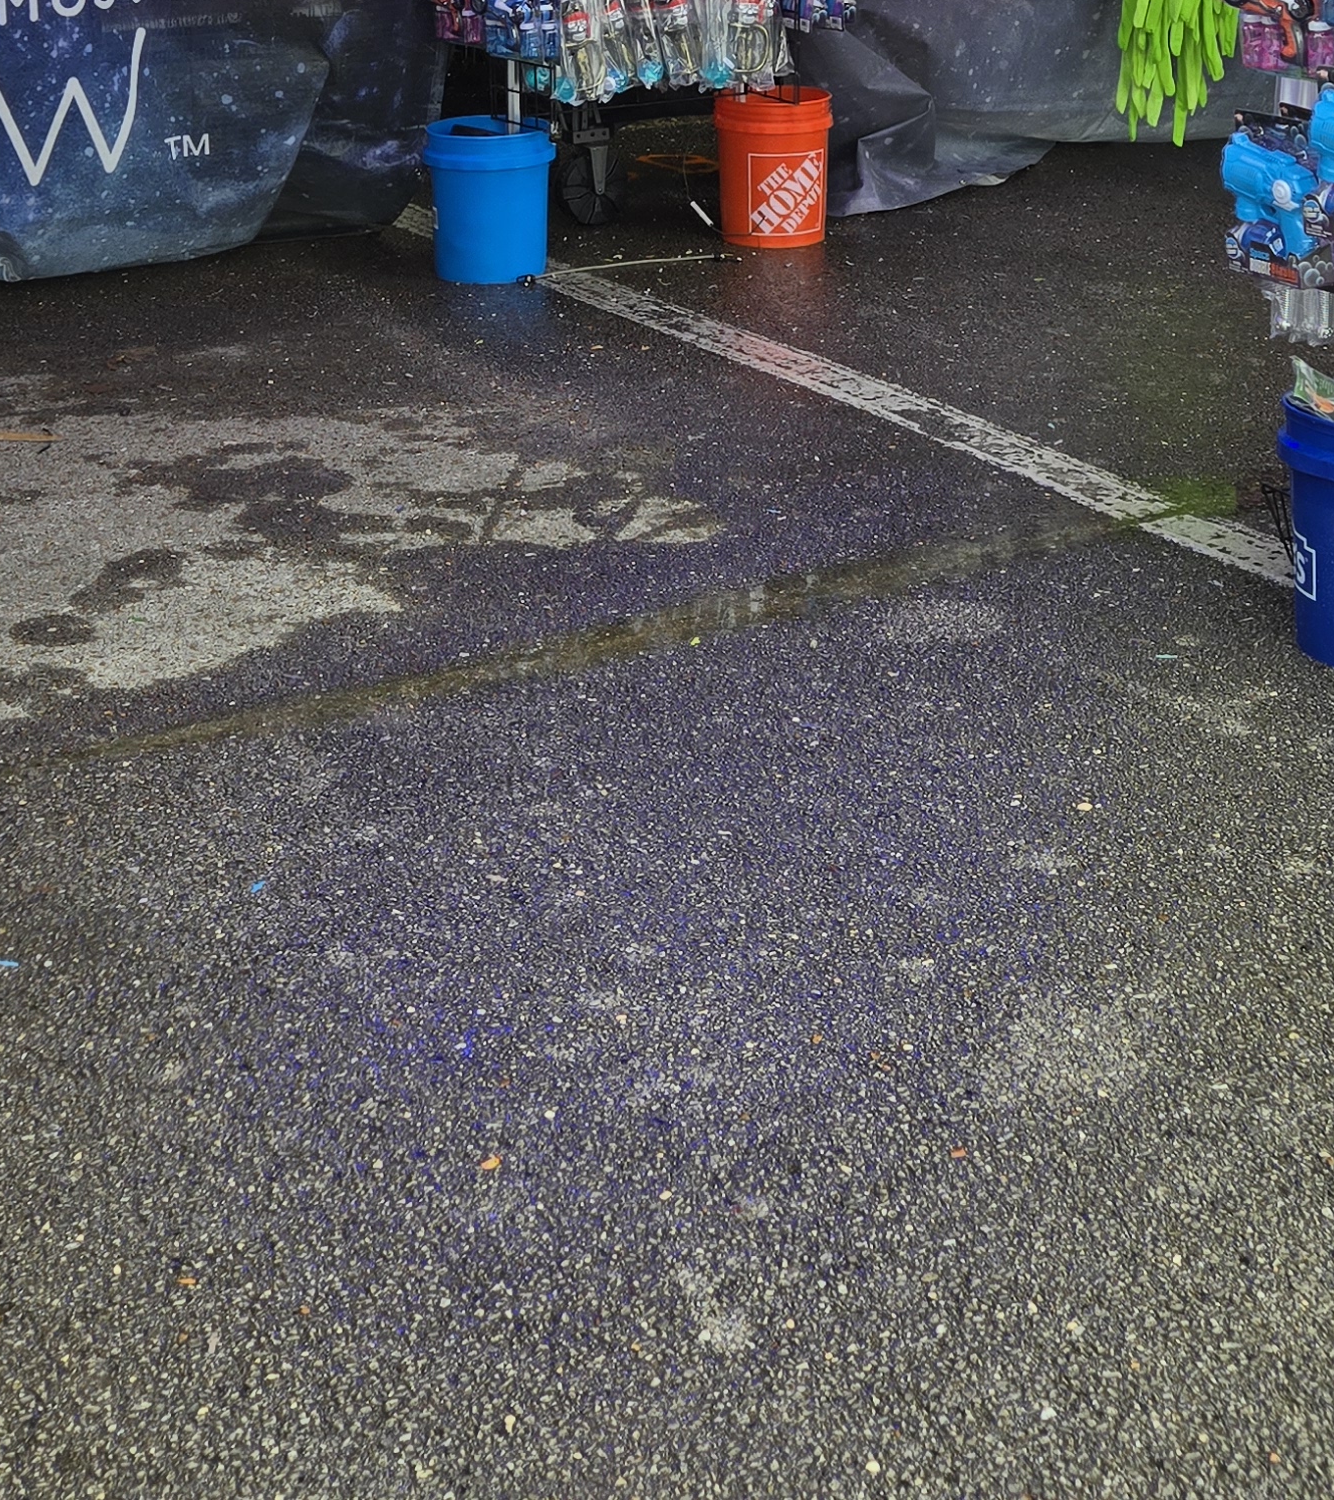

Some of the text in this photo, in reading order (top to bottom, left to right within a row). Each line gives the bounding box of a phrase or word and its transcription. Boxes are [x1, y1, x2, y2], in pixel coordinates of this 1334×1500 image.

[750, 152, 822, 234] HOME
[757, 163, 792, 196] THE
[780, 180, 821, 234] DEPOT
[1249, 248, 1270, 260] Space
